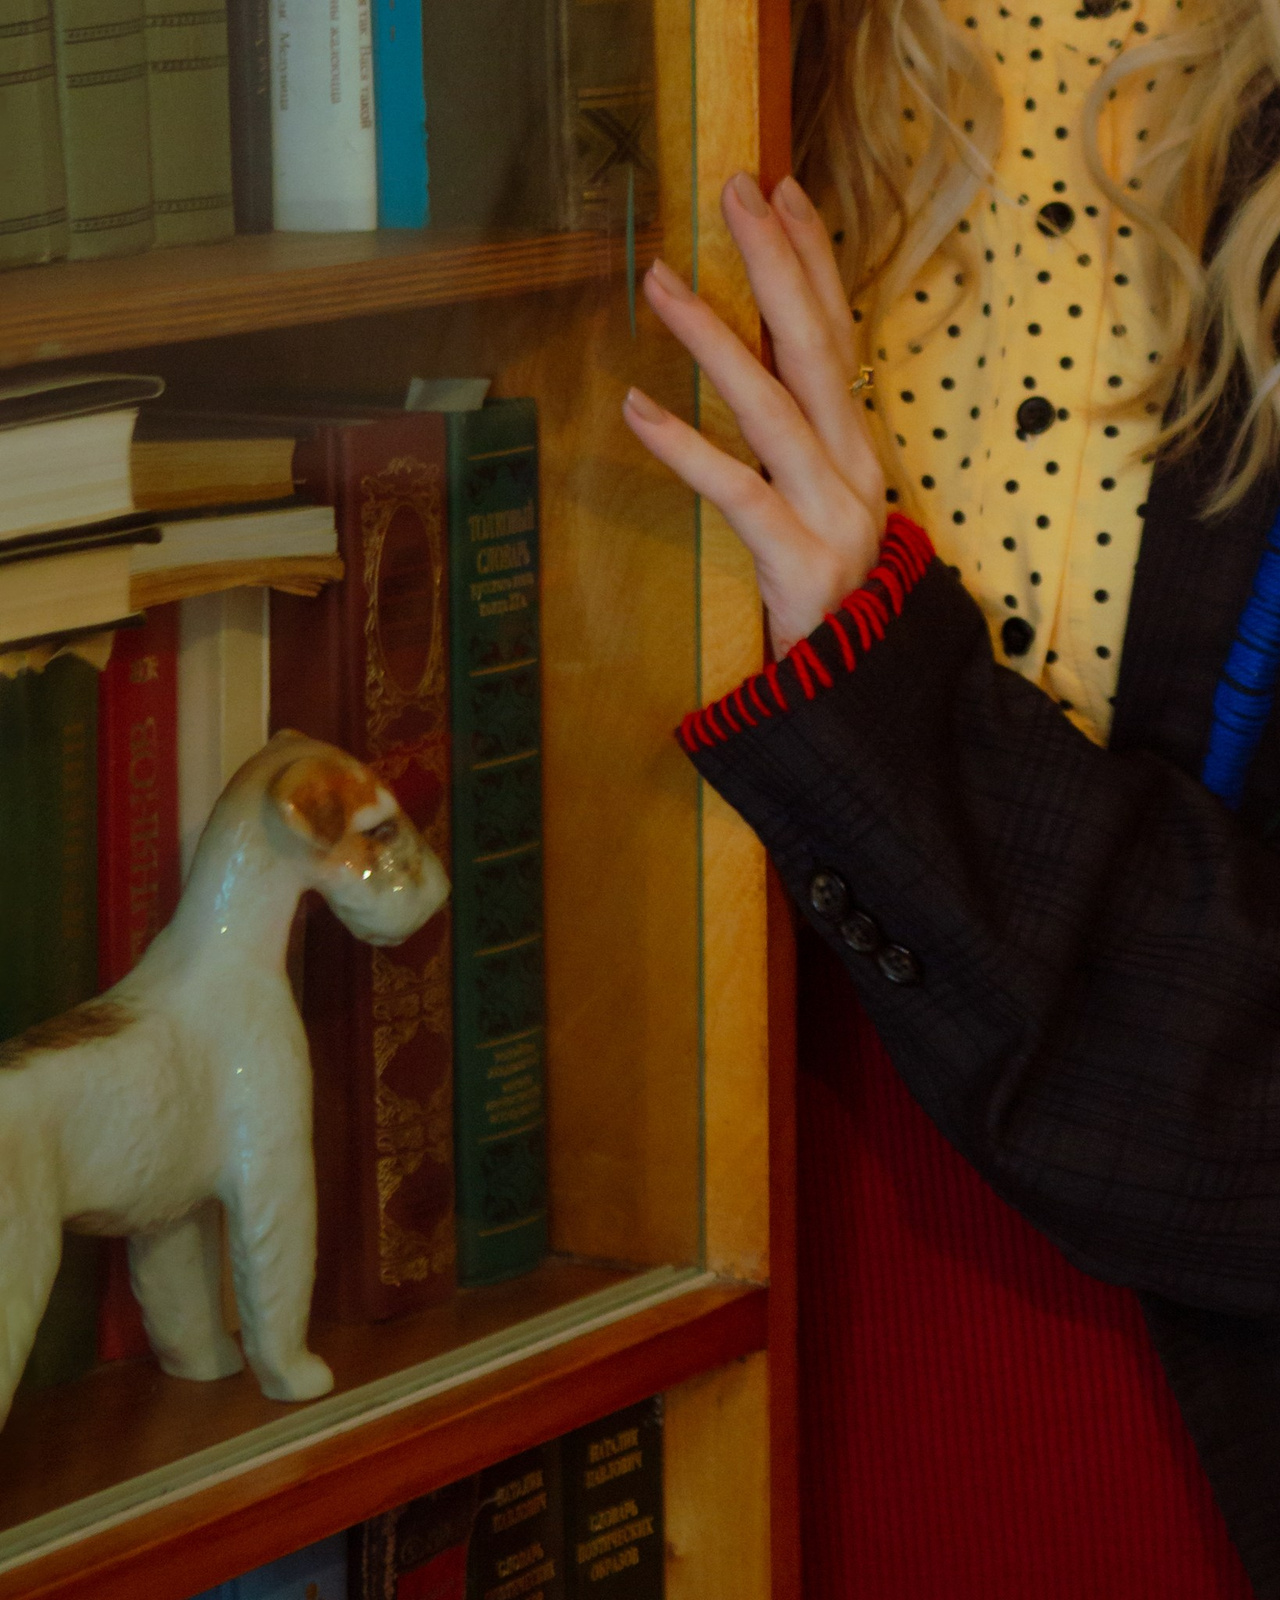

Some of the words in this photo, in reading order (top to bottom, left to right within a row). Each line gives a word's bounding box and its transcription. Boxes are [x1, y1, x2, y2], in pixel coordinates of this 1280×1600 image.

[476, 540, 531, 575] СЛОВАРЬ
[585, 1450, 643, 1490] ПАВЛОВИЧ
[589, 1498, 639, 1533] СЛОВАРЬ
